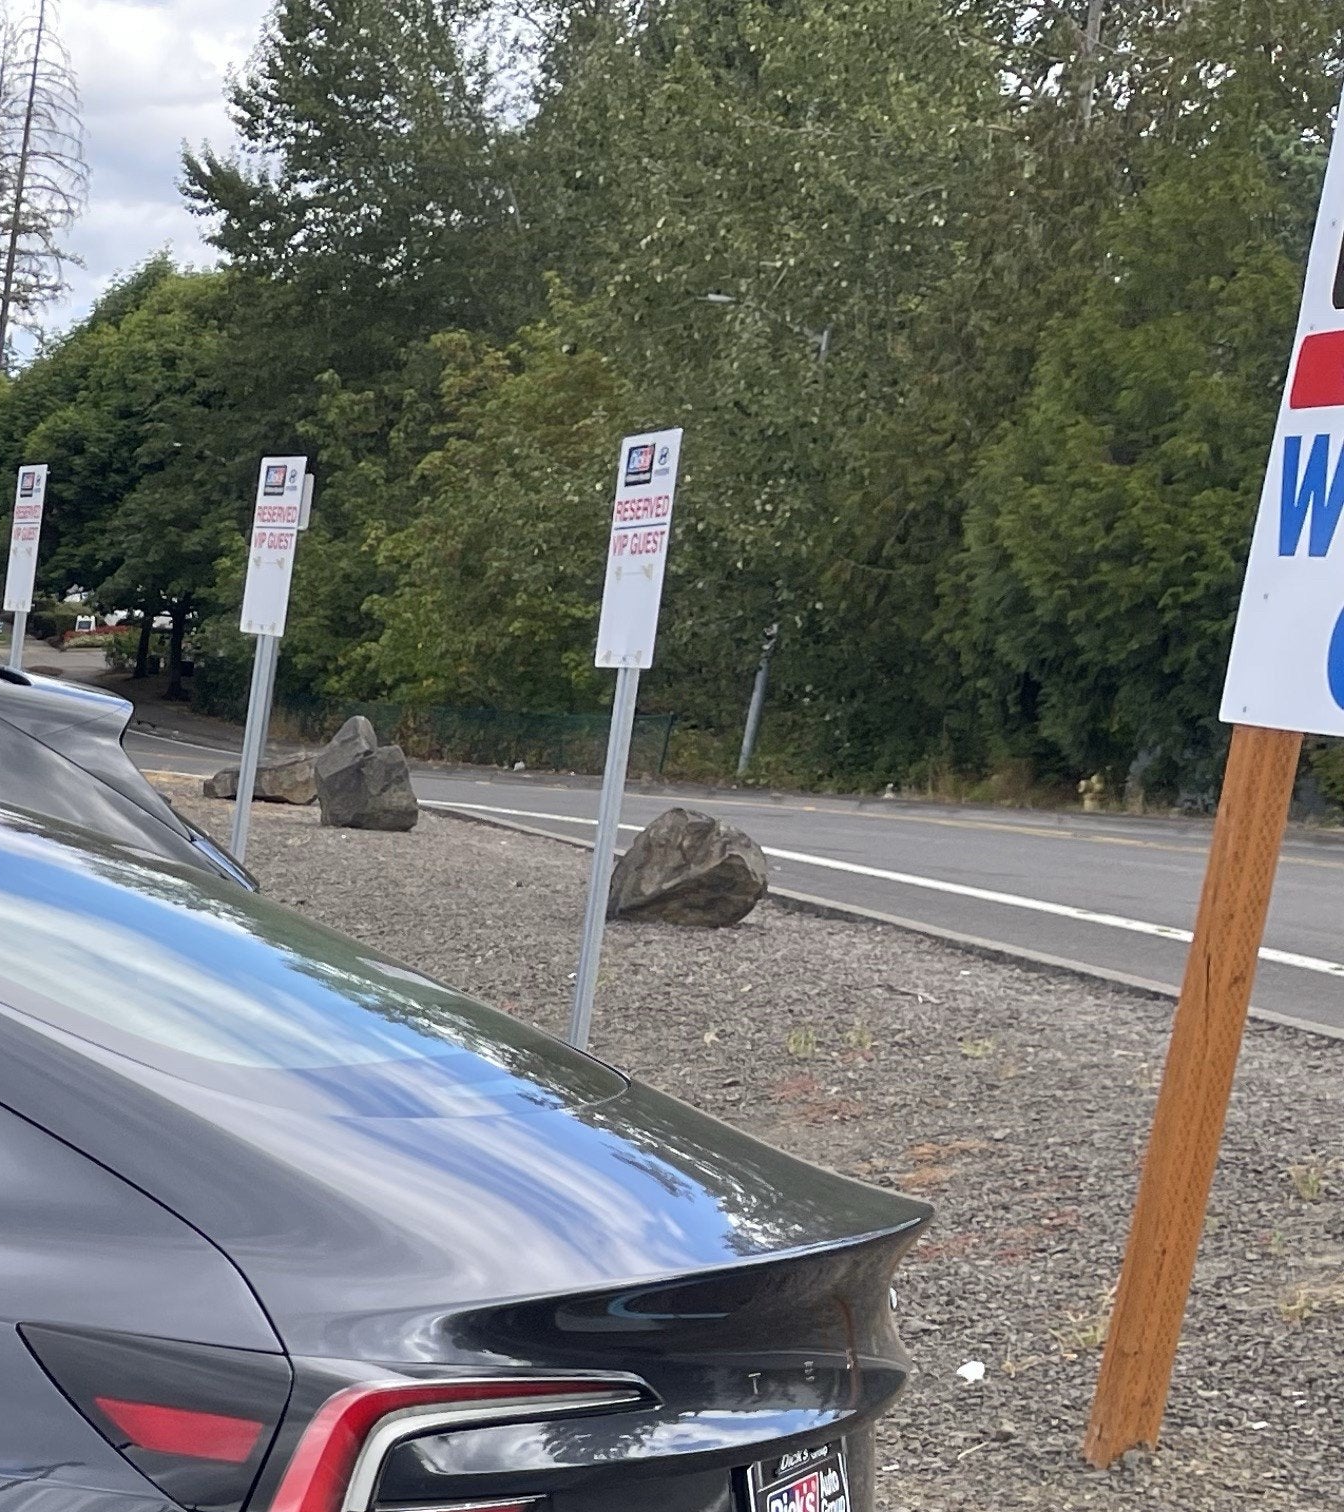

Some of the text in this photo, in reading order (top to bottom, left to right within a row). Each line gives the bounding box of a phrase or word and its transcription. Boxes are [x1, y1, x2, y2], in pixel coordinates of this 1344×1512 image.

[257, 505, 297, 523] RESERVED
[615, 495, 669, 522] RESERVED
[254, 532, 294, 550] VIP GUEST
[613, 531, 666, 556] VIP GUEST
[819, 1468, 840, 1498] Auto
